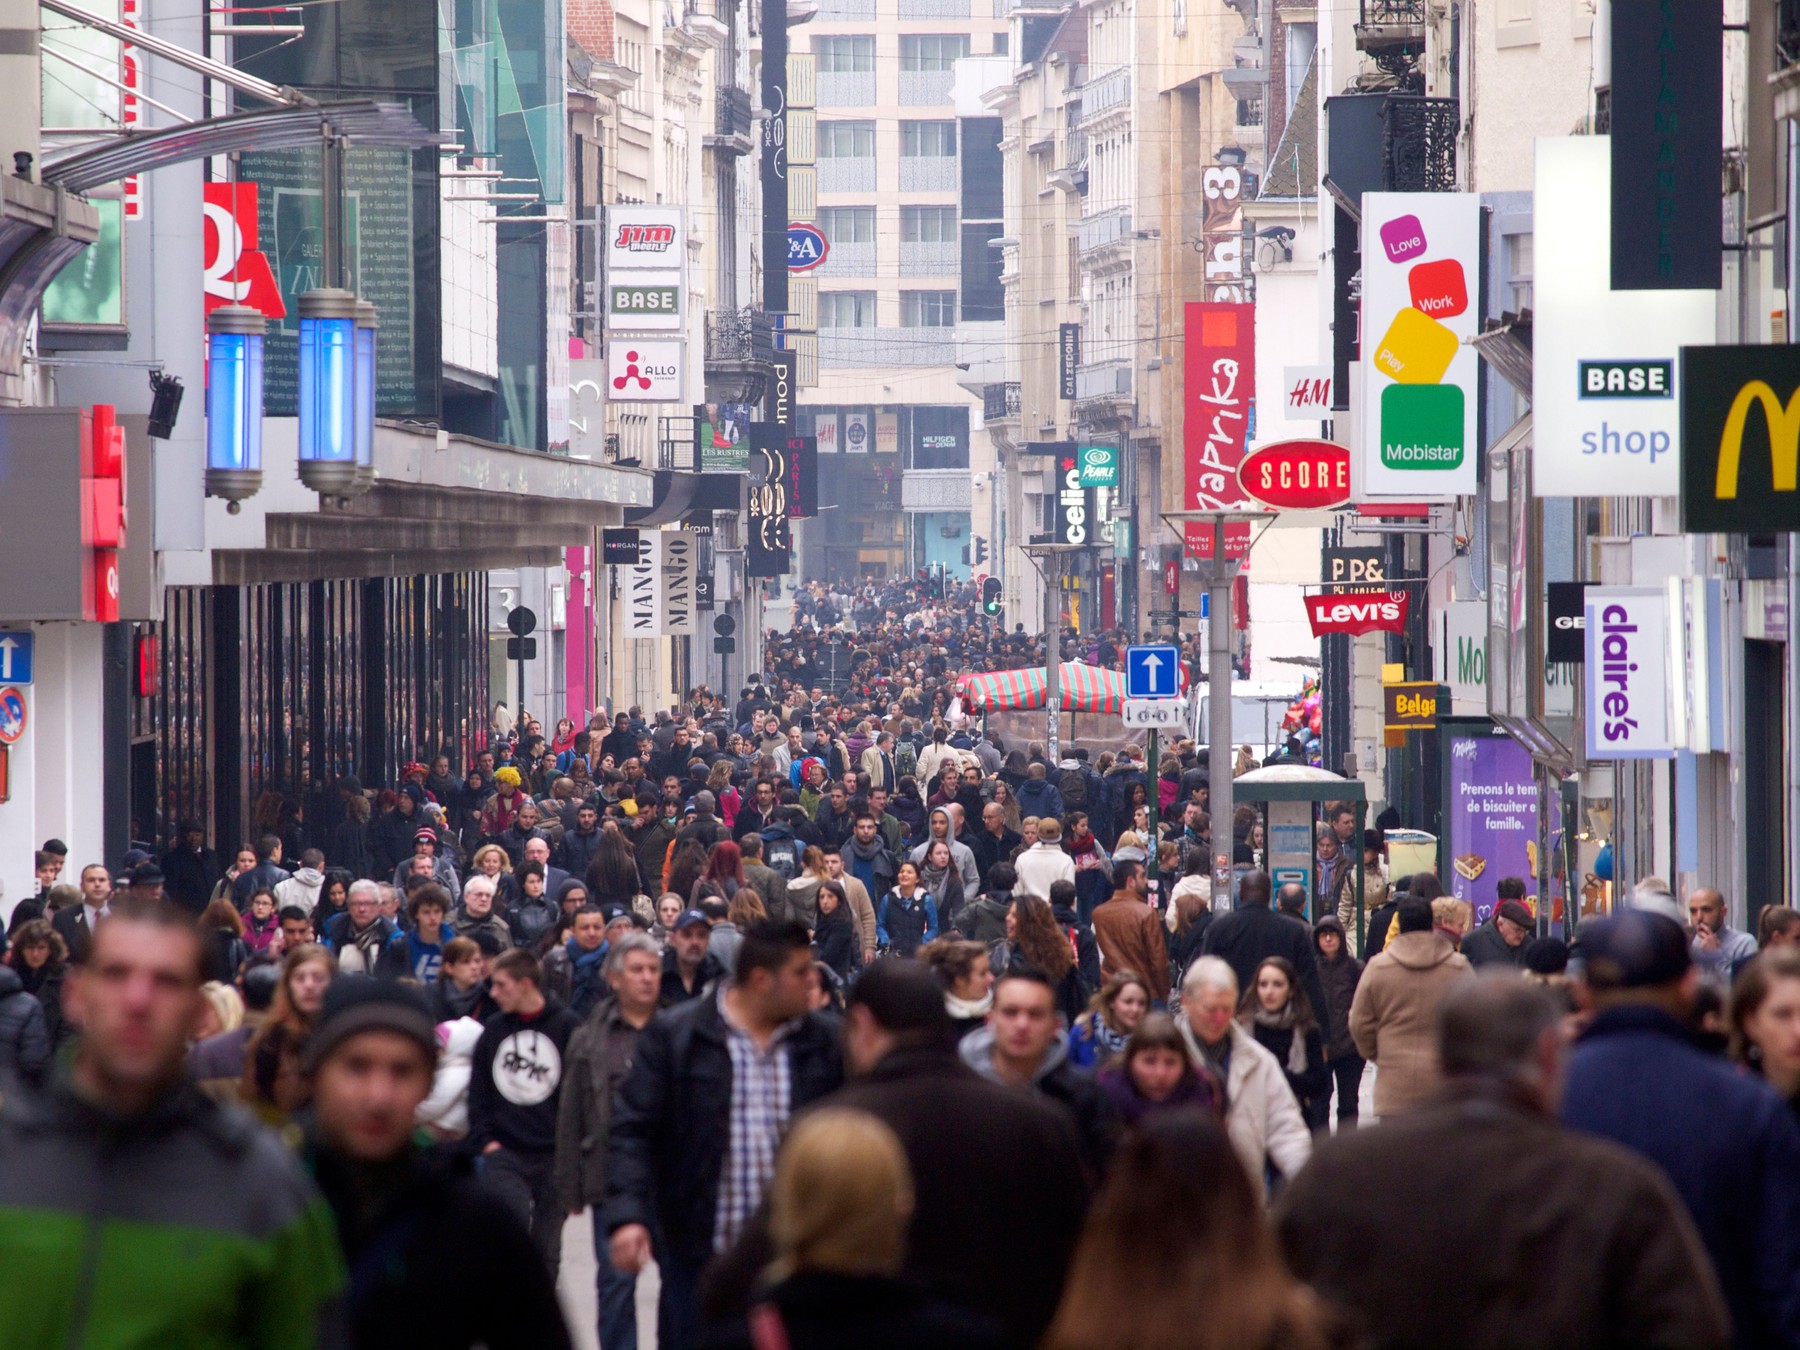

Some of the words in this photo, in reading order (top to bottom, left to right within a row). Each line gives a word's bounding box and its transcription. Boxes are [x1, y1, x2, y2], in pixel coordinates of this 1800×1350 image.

[787, 237, 819, 258] &A
[1390, 236, 1421, 255] Love
[616, 291, 673, 309] BASE
[1419, 295, 1454, 312] Work
[1379, 348, 1405, 373] Play
[645, 365, 676, 376] ALLO
[1587, 367, 1665, 392] BASE
[1289, 378, 1331, 407] H&M
[787, 440, 804, 449] ICI
[1386, 443, 1460, 460] Mobistar
[1582, 421, 1670, 464] shop
[1082, 465, 1115, 478] PEARLE
[1260, 461, 1346, 489] SCORE
[669, 540, 688, 626] MANGO
[1602, 604, 1639, 741] claire's
[1460, 782, 1503, 795] Prenons
[1505, 781, 1514, 795] le
[1517, 783, 1537, 796] tem
[1467, 799, 1480, 813] de
[1483, 799, 1527, 813] biscuiter
[1485, 816, 1525, 830] famille.
